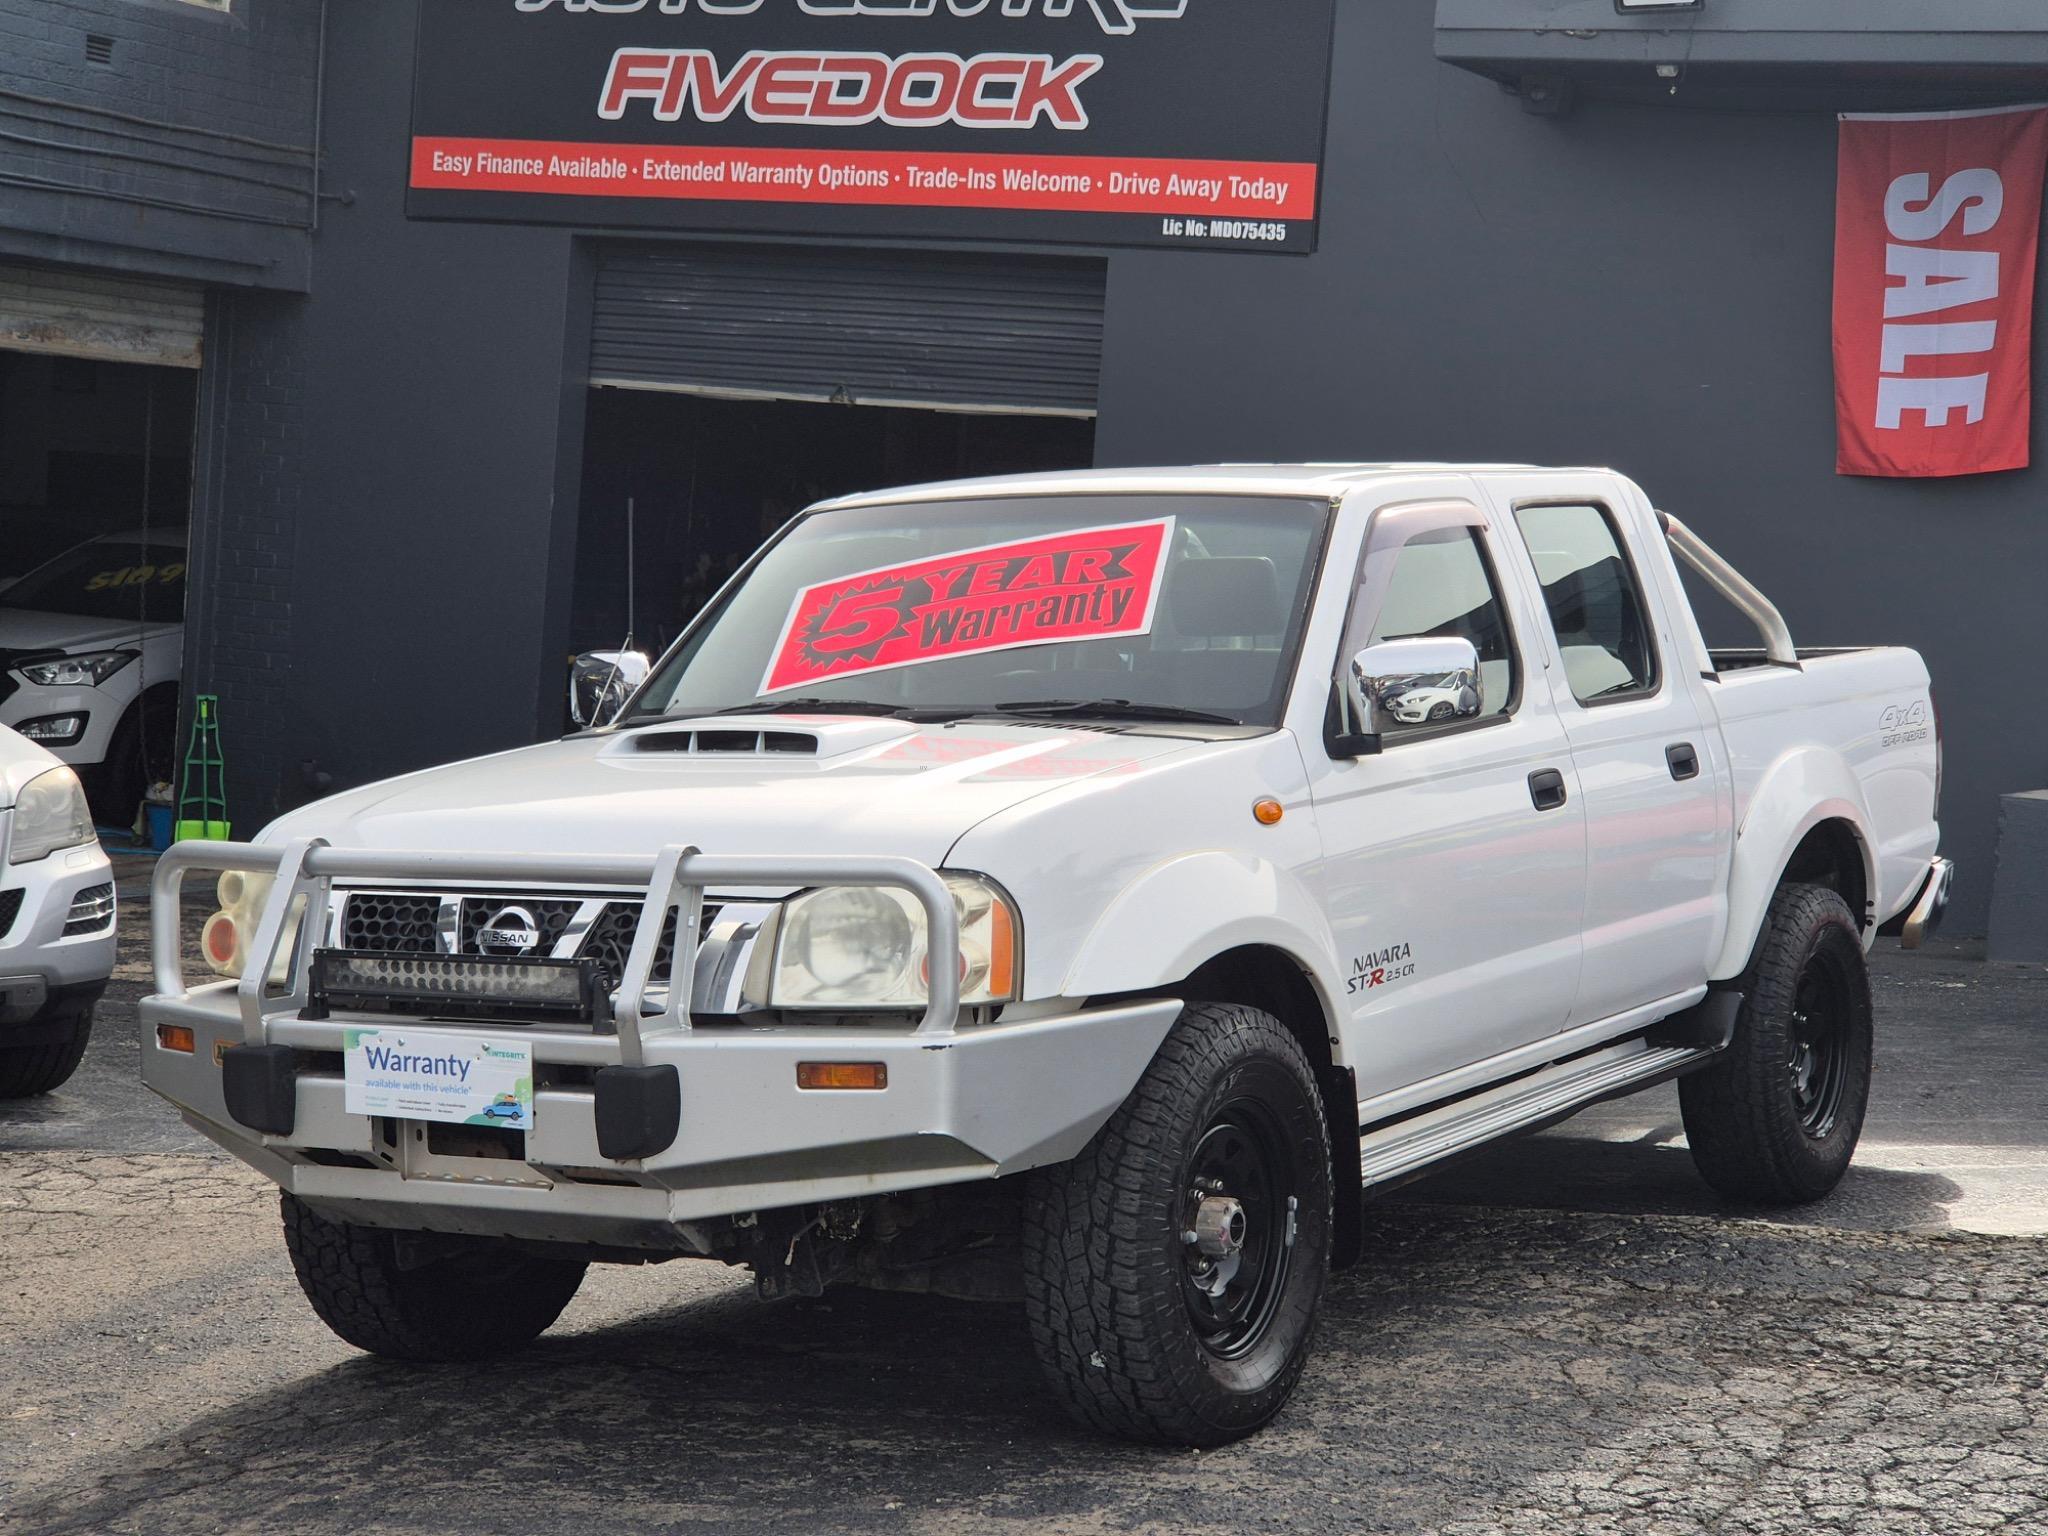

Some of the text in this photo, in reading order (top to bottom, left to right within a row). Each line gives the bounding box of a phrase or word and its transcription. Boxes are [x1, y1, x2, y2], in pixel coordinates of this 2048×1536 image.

[597, 47, 1104, 130] FIVEDOCK
[432, 151, 1288, 204] Easy Finance Available Extended Warranty Options Trade-Ins Welcome Drive Away Today
[1162, 218, 1287, 241] Lic No: MD075435
[1875, 167, 2003, 430] SALE
[810, 549, 1116, 653] 5 YEAR
[918, 583, 1135, 649] Warranty
[481, 930, 529, 943] NISSAN
[1353, 942, 1411, 975] NAVARA
[365, 1045, 471, 1082] Warranty
[366, 1079, 400, 1089] available
[402, 1081, 421, 1091] with
[423, 1082, 438, 1092] this
